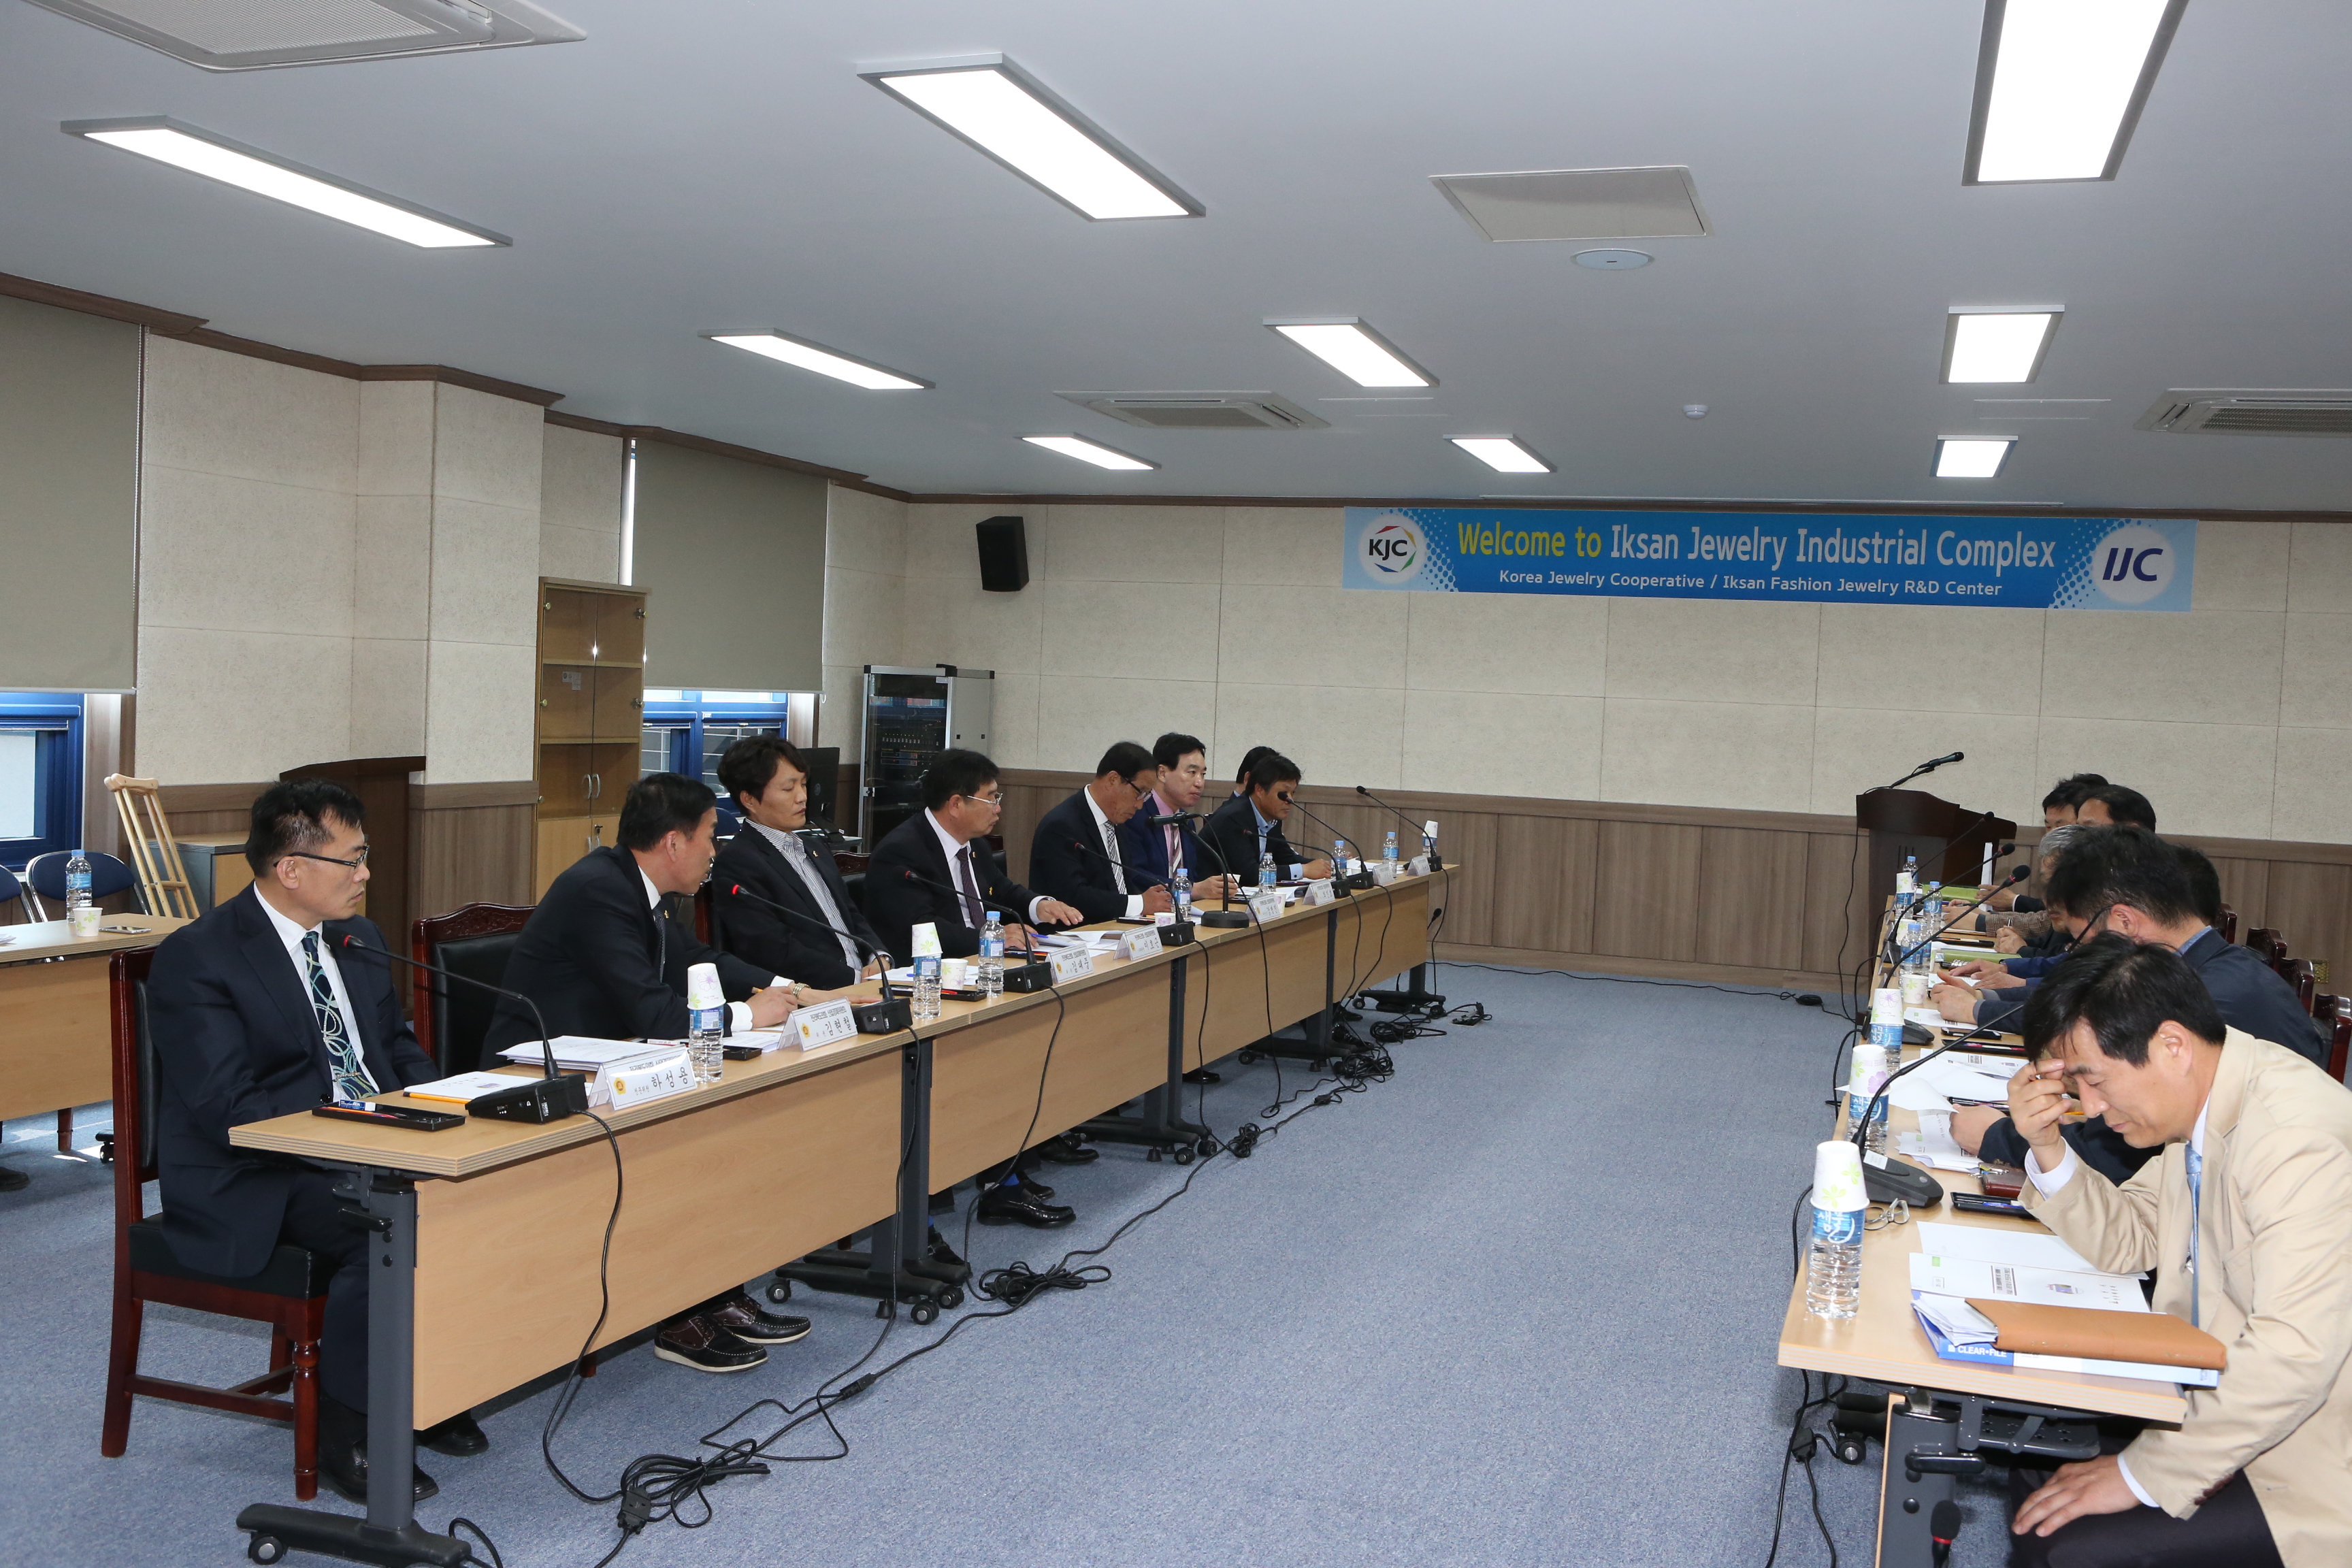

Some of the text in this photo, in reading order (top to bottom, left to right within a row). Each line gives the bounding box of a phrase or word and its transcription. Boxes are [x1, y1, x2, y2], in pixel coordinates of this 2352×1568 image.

[1369, 538, 1408, 561] KJC
[1458, 523, 2056, 576] Welcome to Iksan Jewelry Industrial Complex
[2102, 547, 2163, 582] IJC
[1499, 570, 2002, 596] Korea Jewelry Cooperative / Iksan Fashion Jewelry R&D Center
